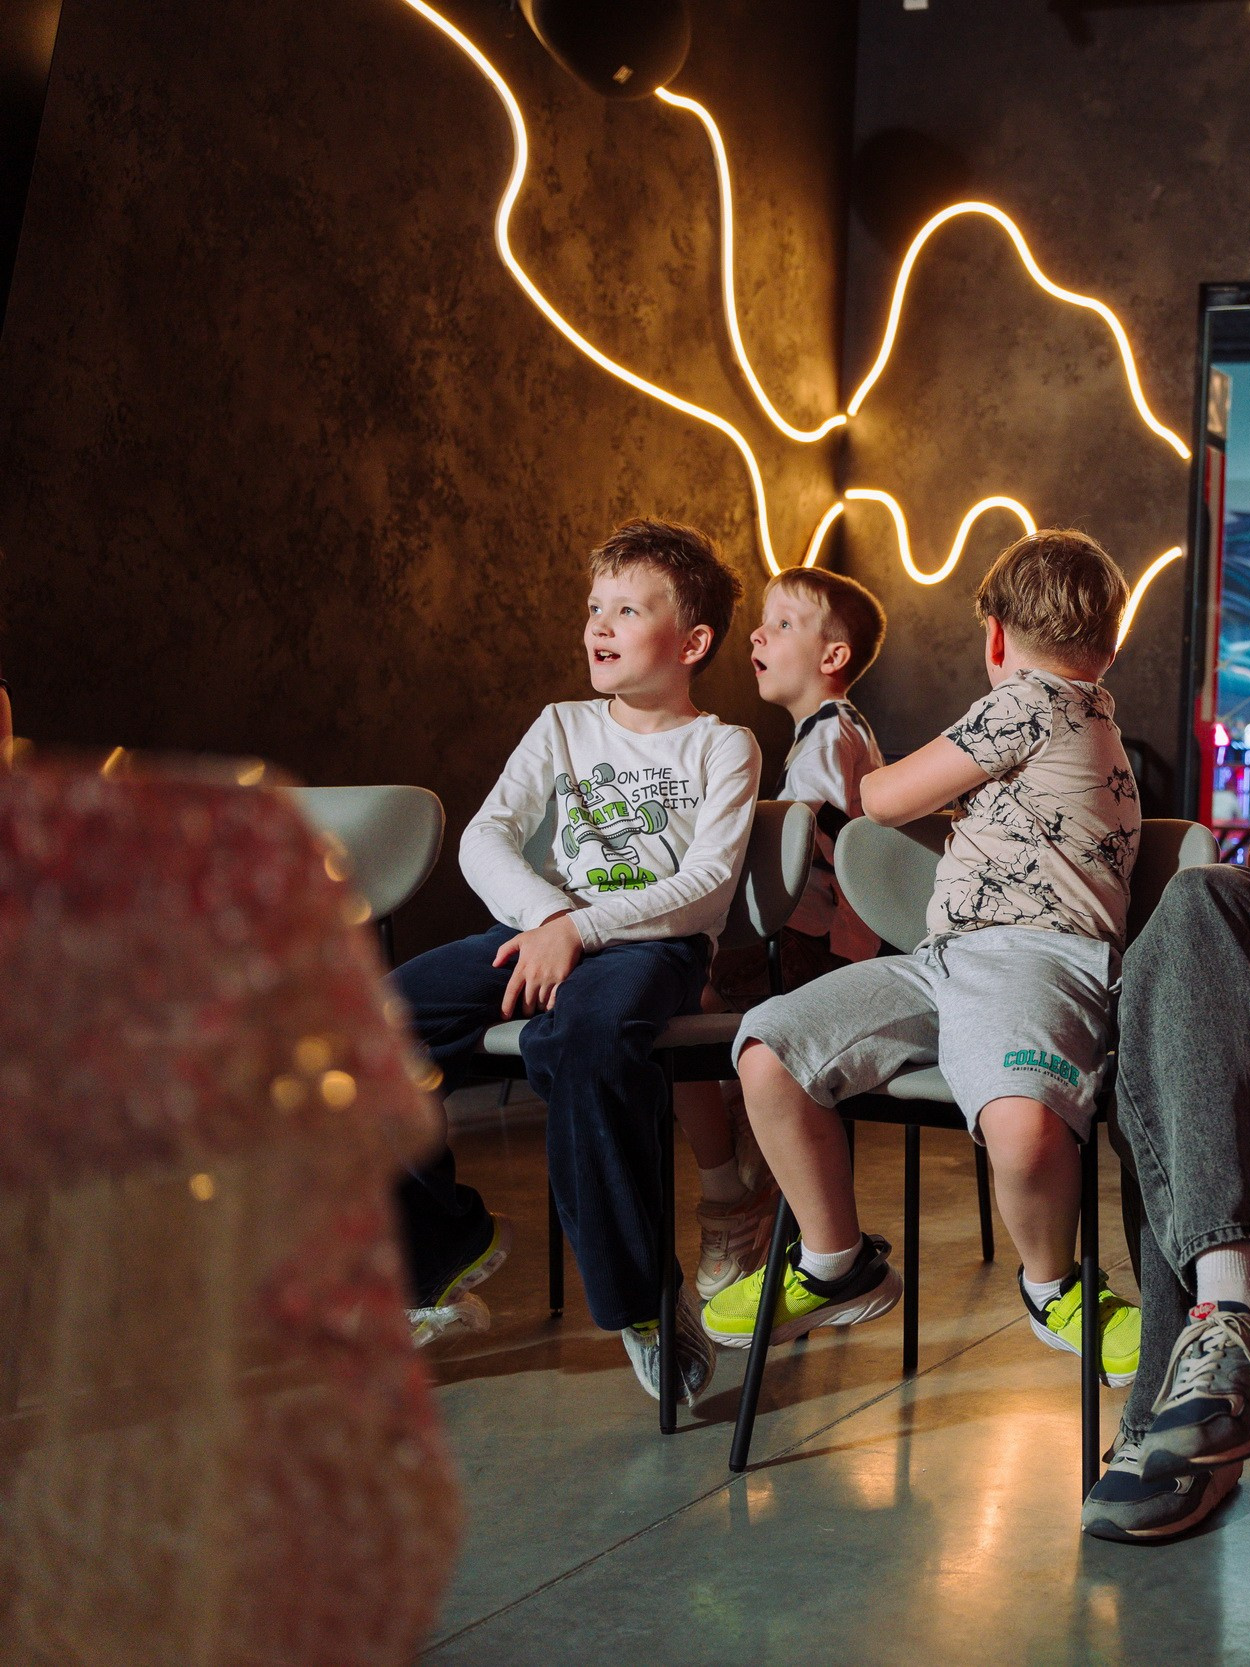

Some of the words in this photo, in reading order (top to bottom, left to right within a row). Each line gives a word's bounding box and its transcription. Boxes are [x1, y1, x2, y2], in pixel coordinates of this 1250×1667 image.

[617, 771, 640, 785] ON
[642, 767, 673, 781] THE
[631, 780, 690, 802] STREET
[662, 797, 699, 810] CITY
[1003, 1049, 1080, 1087] COLLEGE
